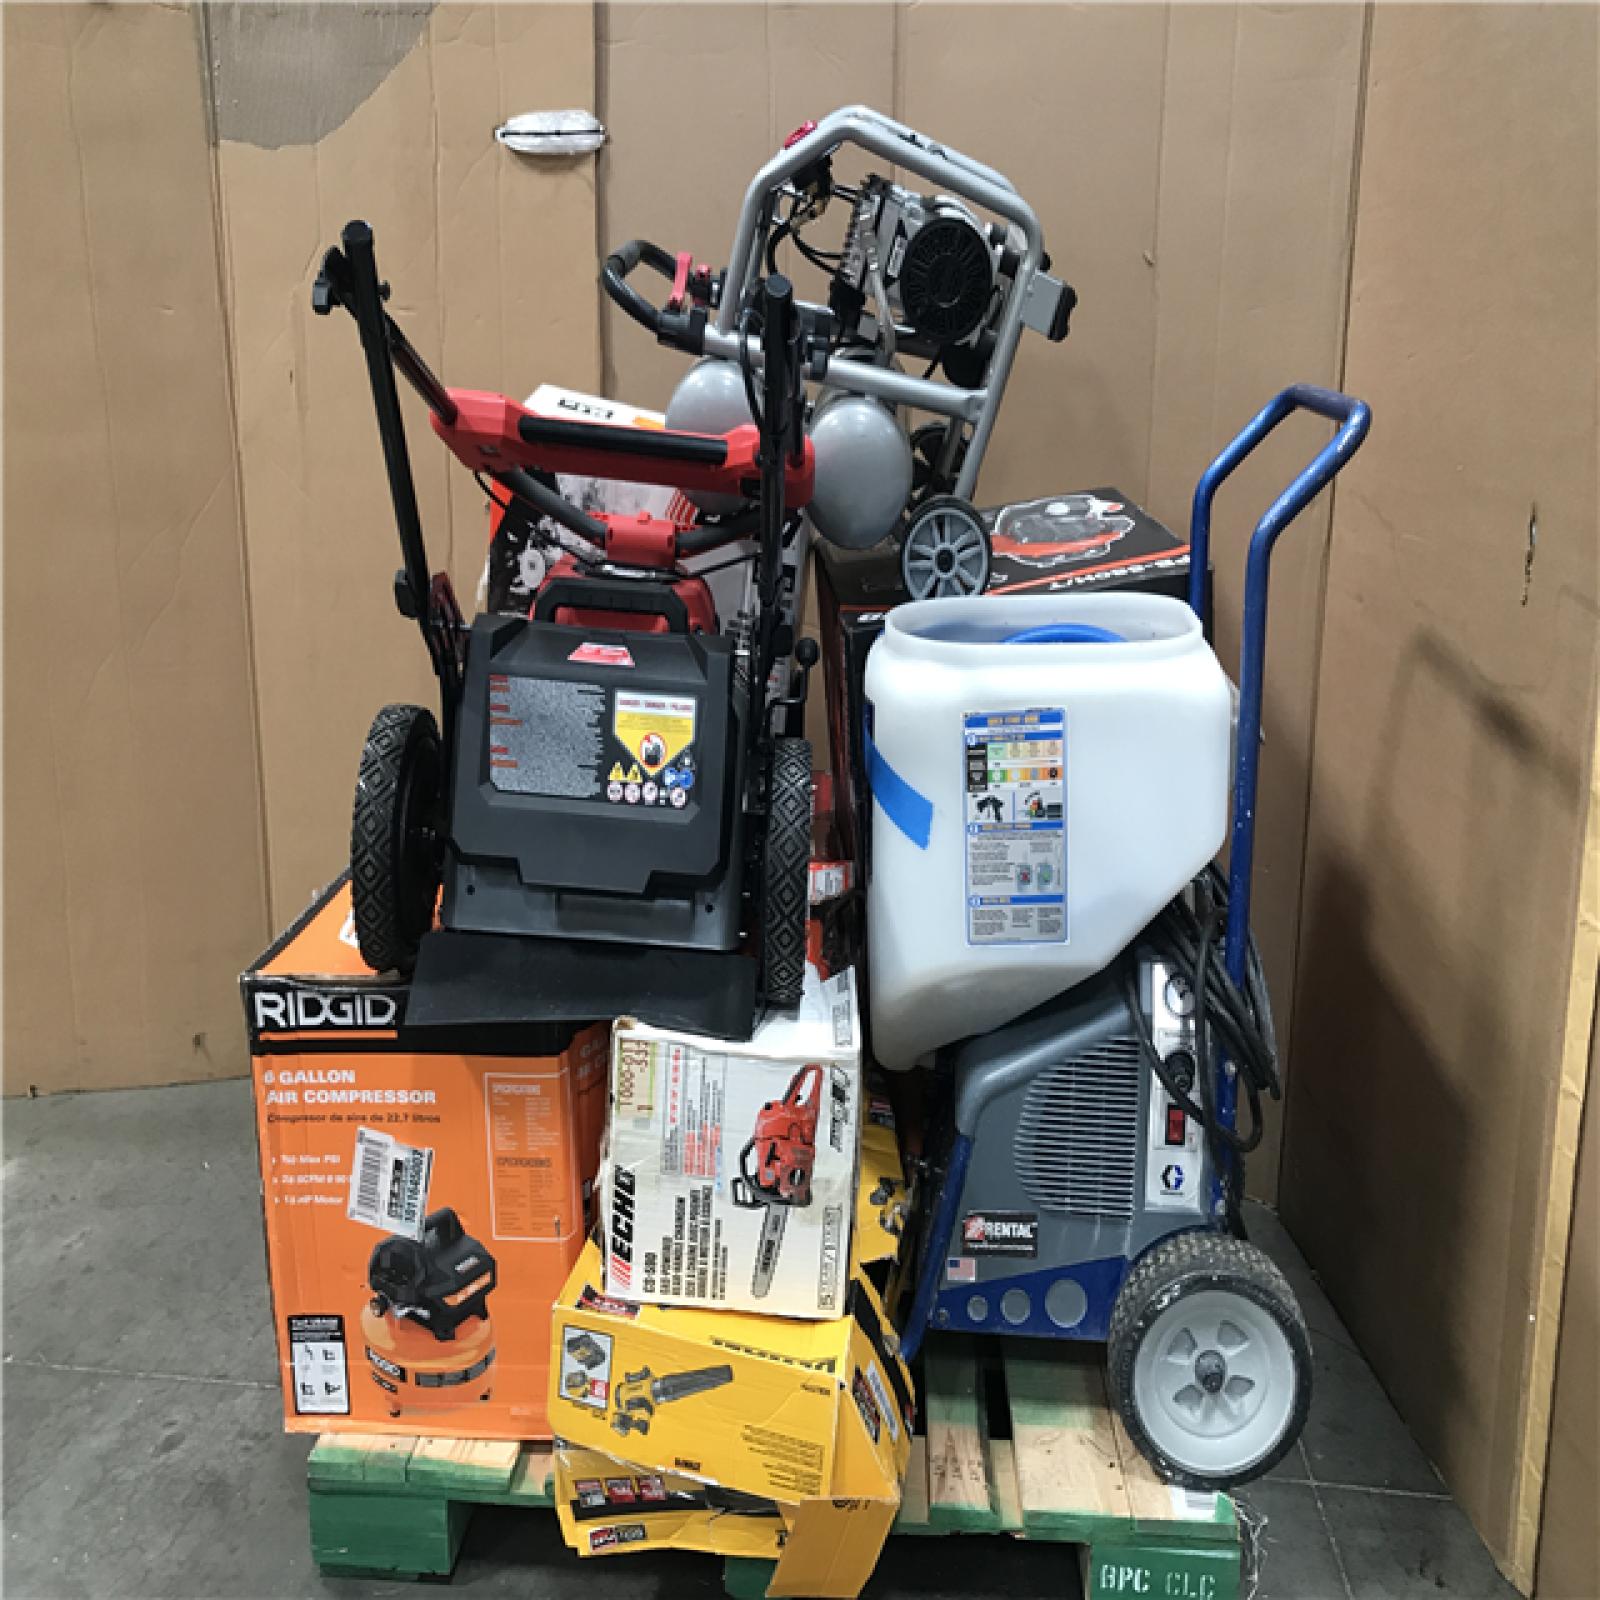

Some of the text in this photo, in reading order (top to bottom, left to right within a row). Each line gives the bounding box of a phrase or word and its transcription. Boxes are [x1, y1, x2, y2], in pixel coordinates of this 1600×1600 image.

[254, 991, 396, 1028] RIDGID
[279, 1070, 356, 1085] GALLON
[265, 1089, 436, 1104] AIR COMPRESSOR
[611, 1165, 636, 1263] ECHO
[984, 1221, 1034, 1239] RENTAL
